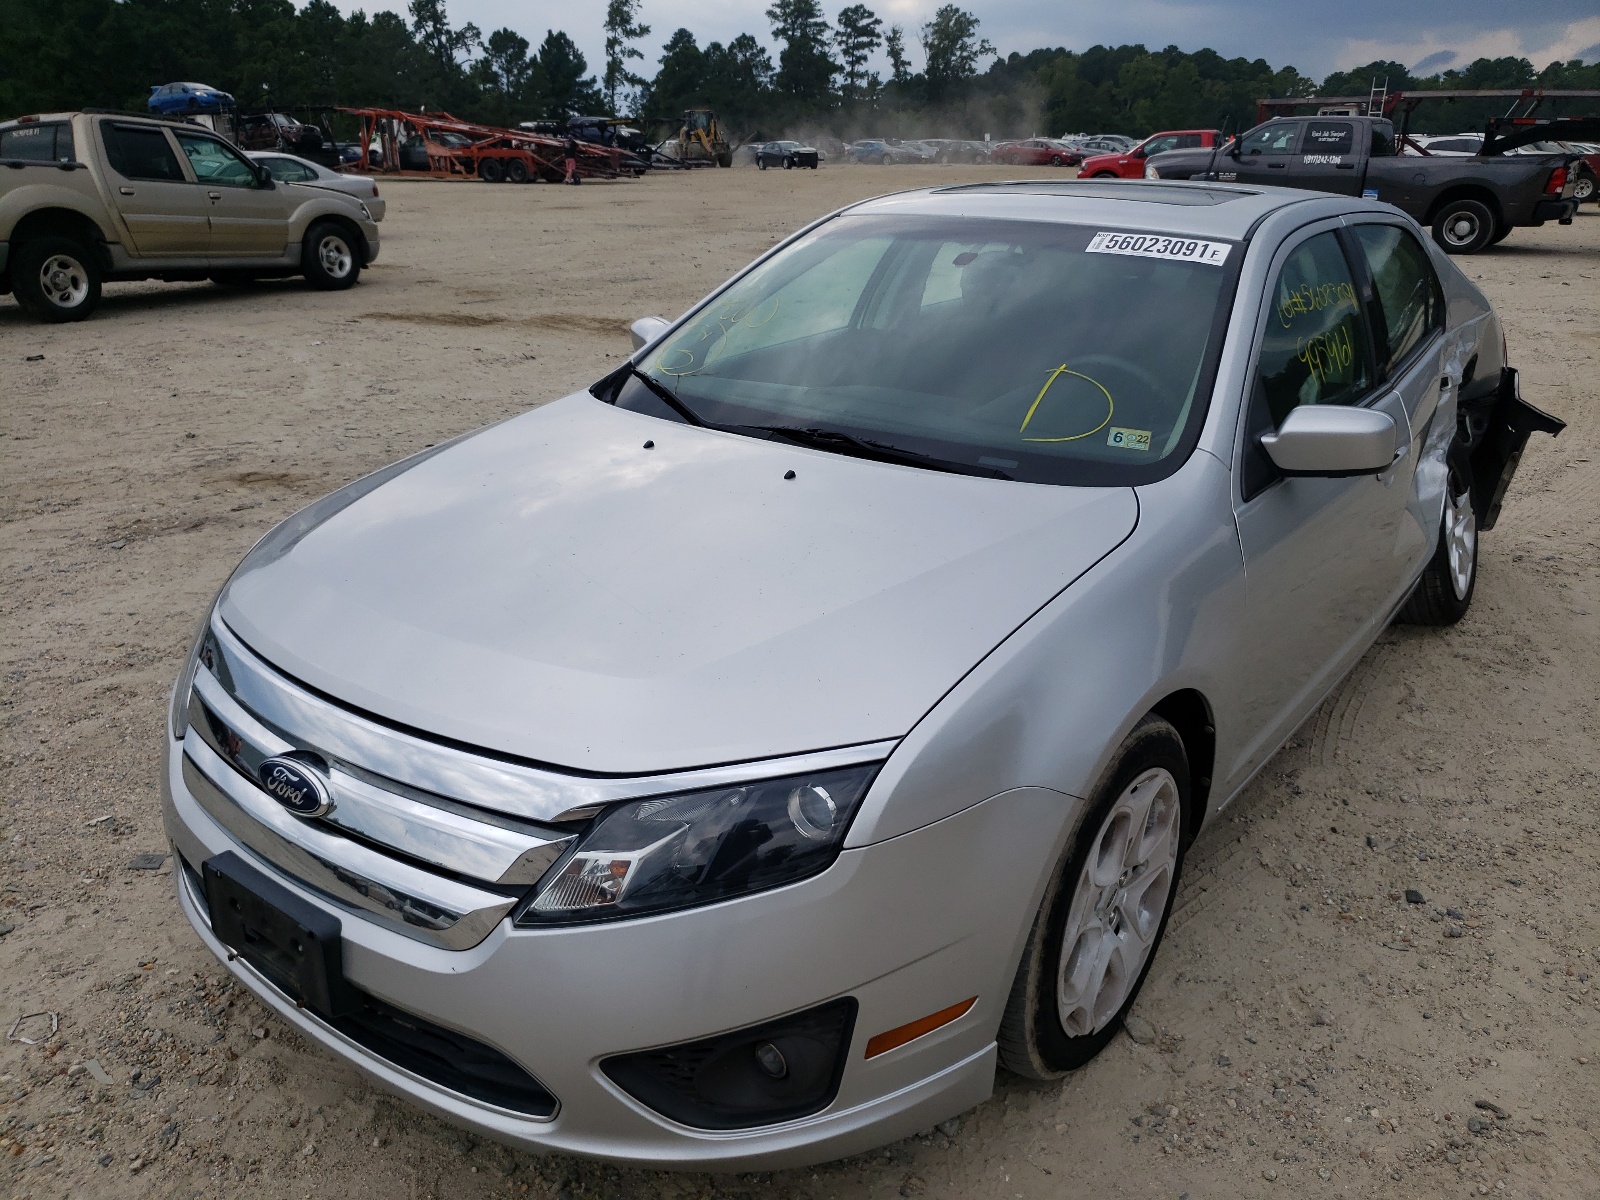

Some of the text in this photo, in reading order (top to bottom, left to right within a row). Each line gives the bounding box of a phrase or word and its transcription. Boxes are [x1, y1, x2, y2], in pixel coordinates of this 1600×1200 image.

[1105, 234, 1210, 259] 56023091
[1210, 249, 1220, 259] F
[1112, 431, 1149, 444] 6 22
[267, 766, 308, 806] Ford
